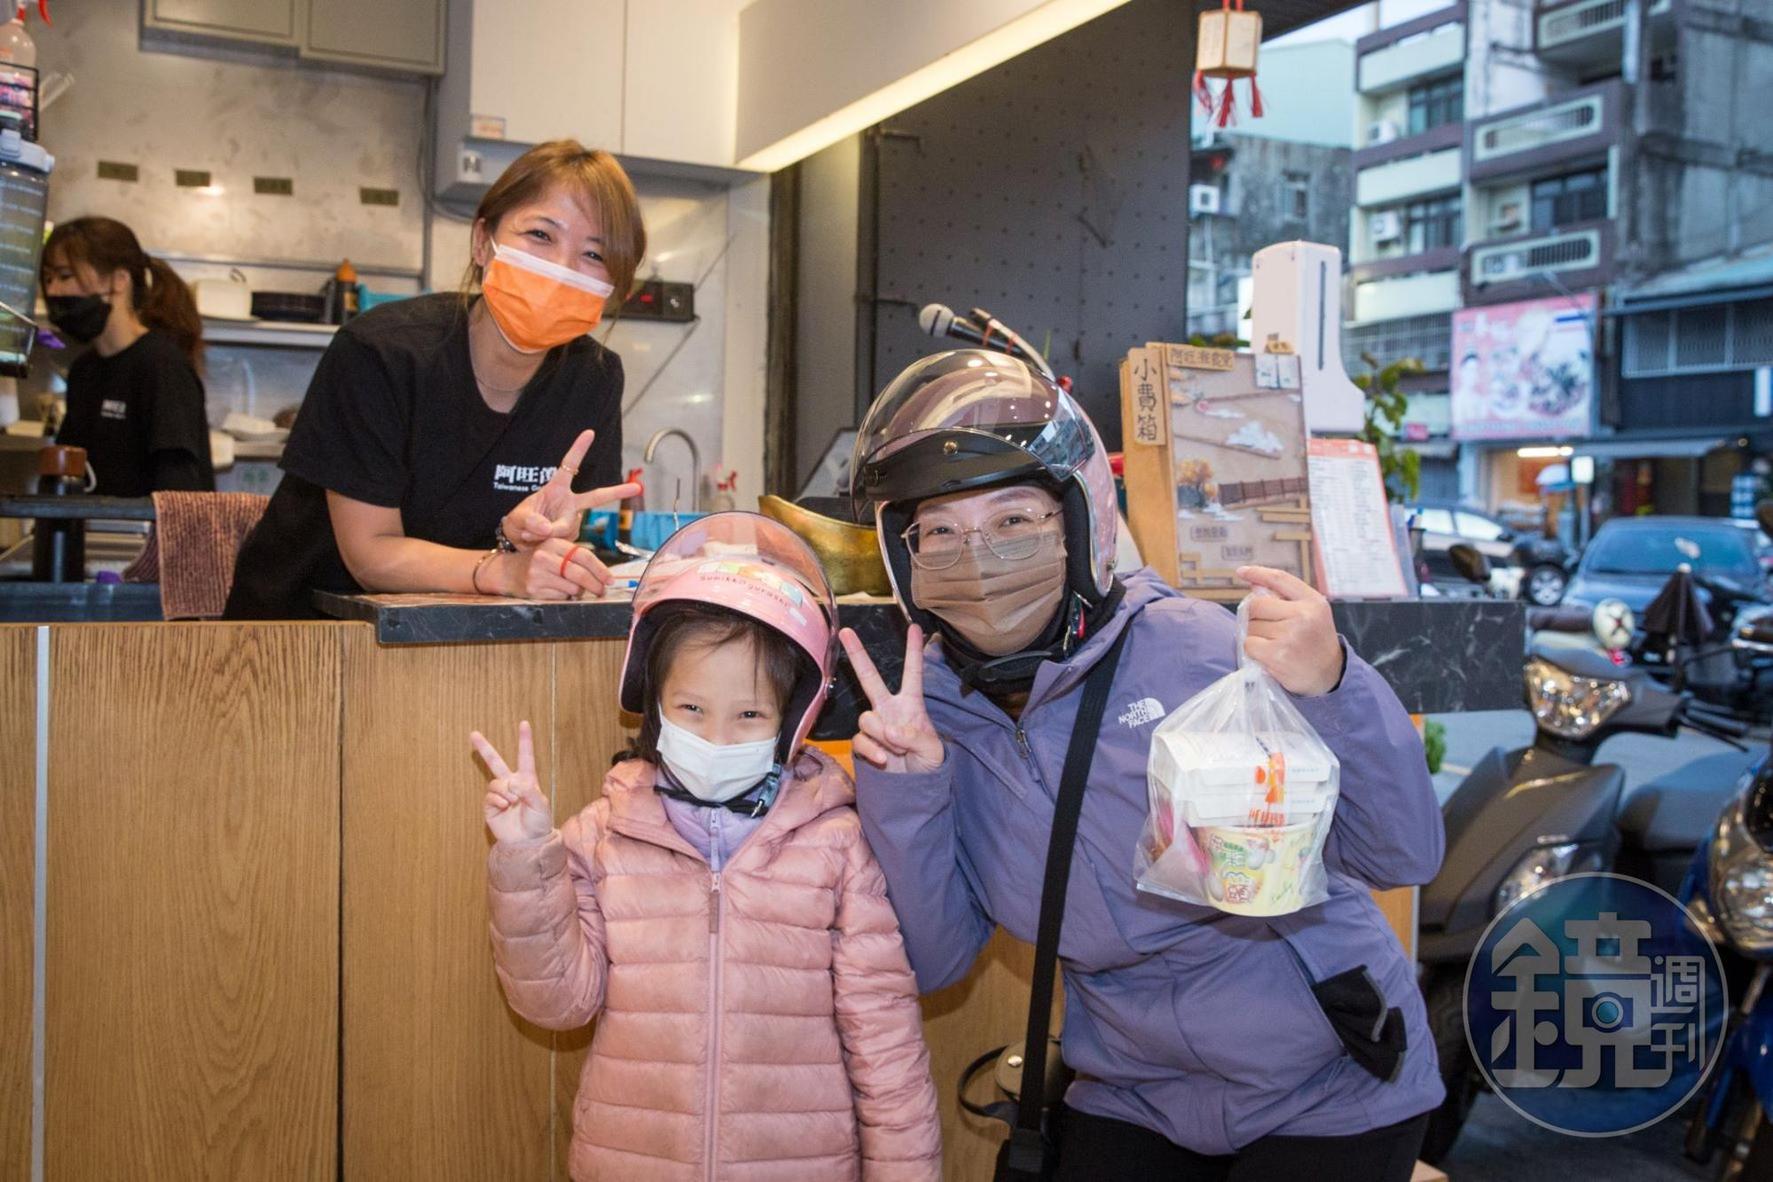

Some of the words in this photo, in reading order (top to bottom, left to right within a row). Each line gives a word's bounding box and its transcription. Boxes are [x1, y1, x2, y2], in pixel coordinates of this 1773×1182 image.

[493, 481, 529, 492] Taiwanese
[1127, 699, 1146, 712] THE
[1118, 706, 1149, 725] NORTH
[1128, 714, 1151, 729] FACE
